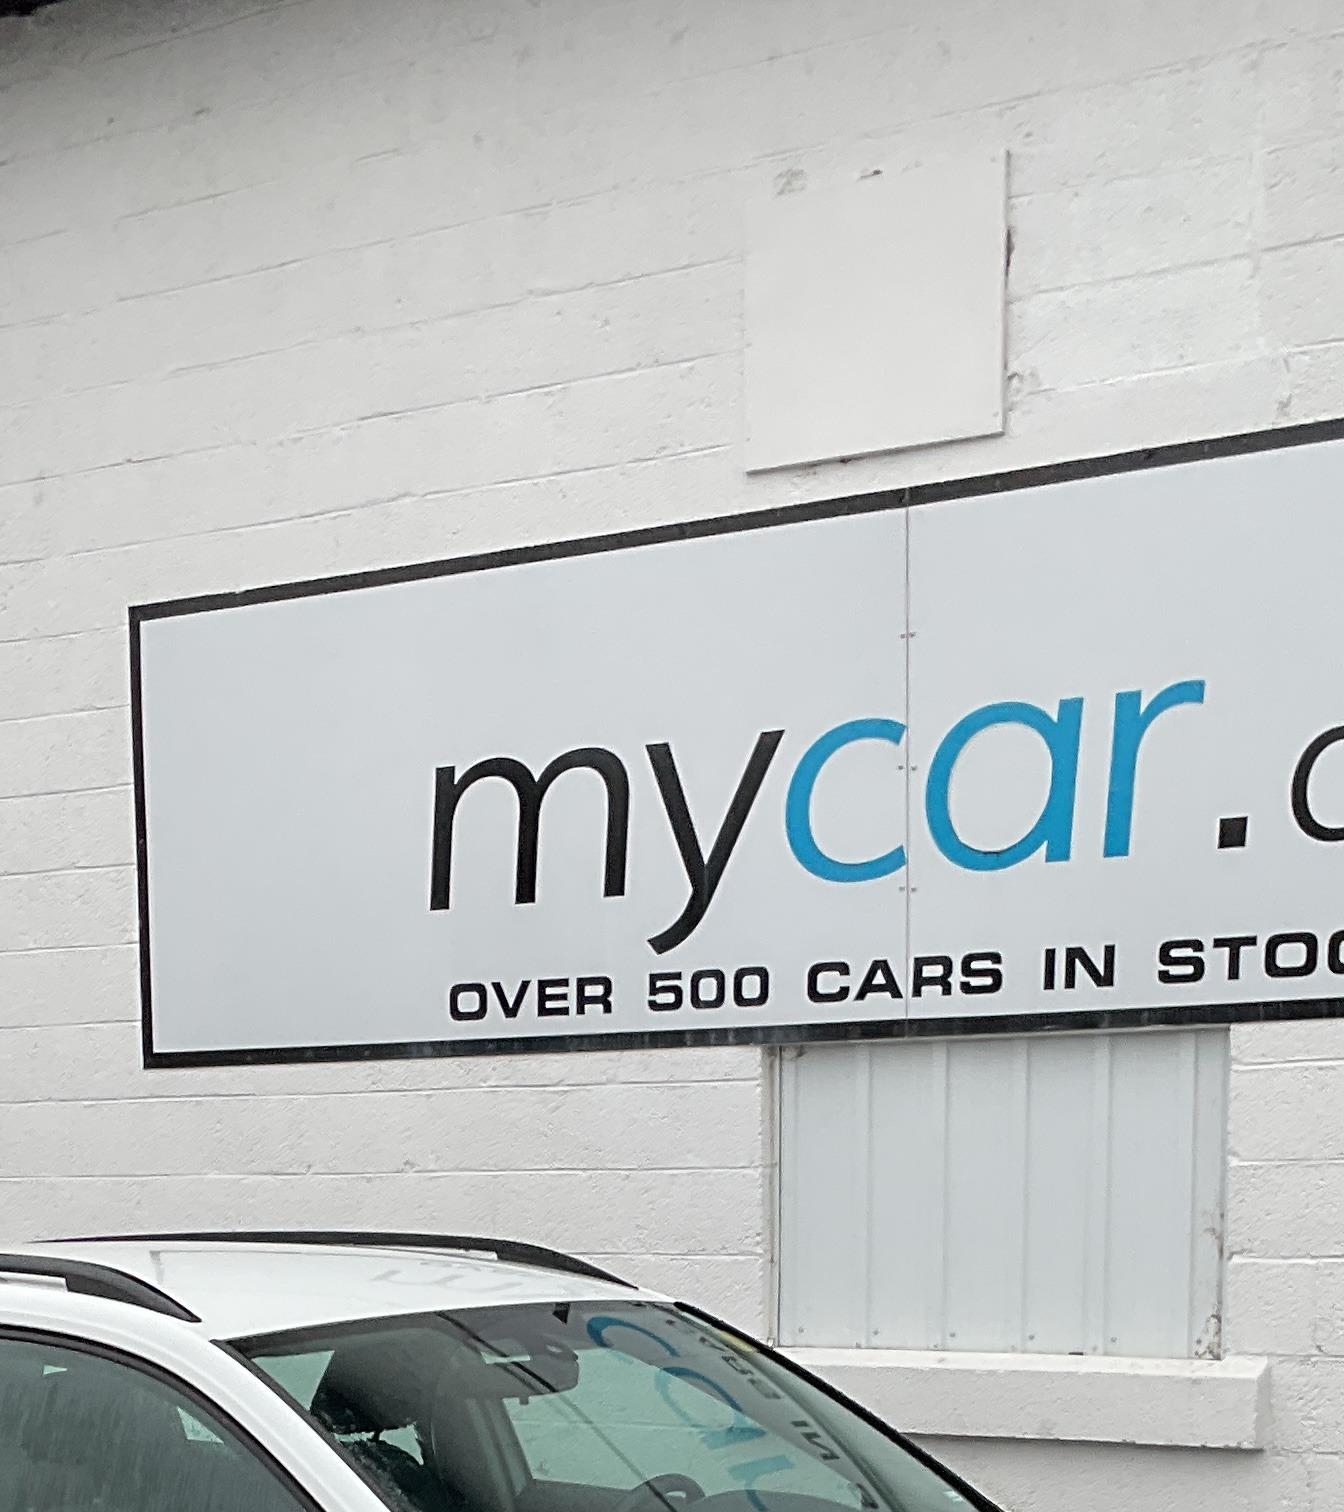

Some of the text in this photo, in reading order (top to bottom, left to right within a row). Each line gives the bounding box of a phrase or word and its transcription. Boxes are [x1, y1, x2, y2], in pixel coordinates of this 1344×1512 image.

[449, 975, 613, 1022] OVER
[647, 966, 770, 1012] 500
[807, 951, 1003, 1003] CARS
[1043, 943, 1116, 991] IN
